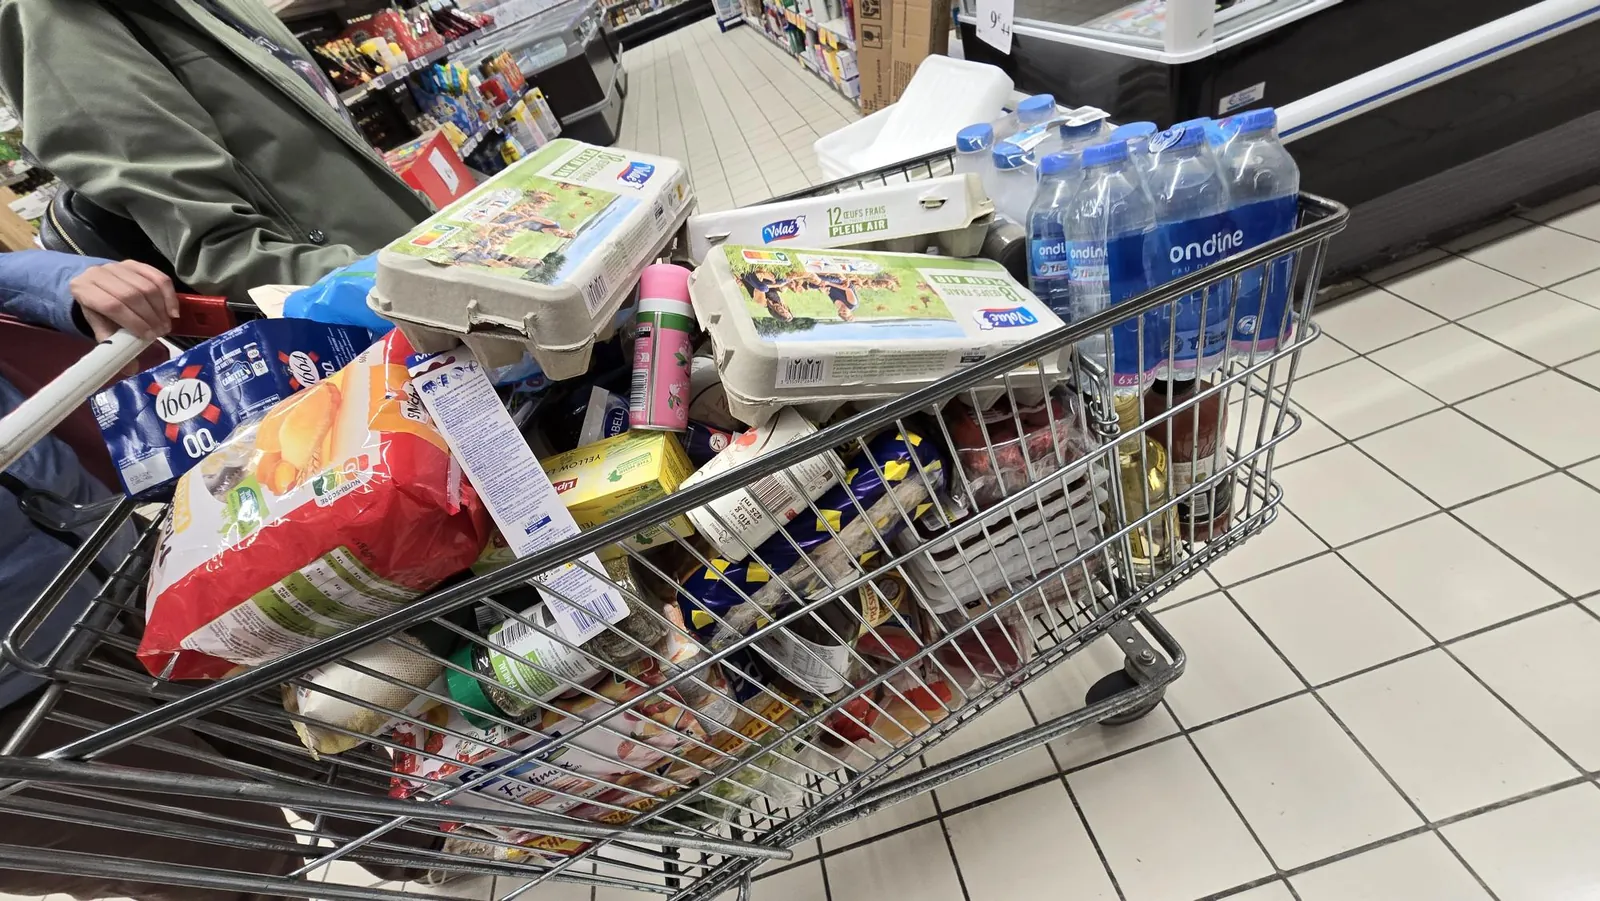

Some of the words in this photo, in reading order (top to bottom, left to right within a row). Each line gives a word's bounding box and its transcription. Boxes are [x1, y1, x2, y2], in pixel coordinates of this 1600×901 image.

[826, 207, 843, 226] 12
[865, 205, 887, 218] FRAIS
[764, 220, 795, 239] Volaé
[832, 222, 863, 236] PLEIN
[866, 219, 886, 231] AIR
[1039, 242, 1066, 256] ondi
[1169, 229, 1244, 264] ondine
[934, 275, 961, 284] AIR
[963, 276, 1010, 287] PLEIN
[998, 286, 1027, 302] 18
[989, 311, 1034, 326] Volaé
[161, 382, 207, 419] 1664
[559, 454, 601, 473] YELLOW
[741, 496, 752, 507] ml
[738, 513, 751, 526] 410
[749, 507, 763, 520] 425
